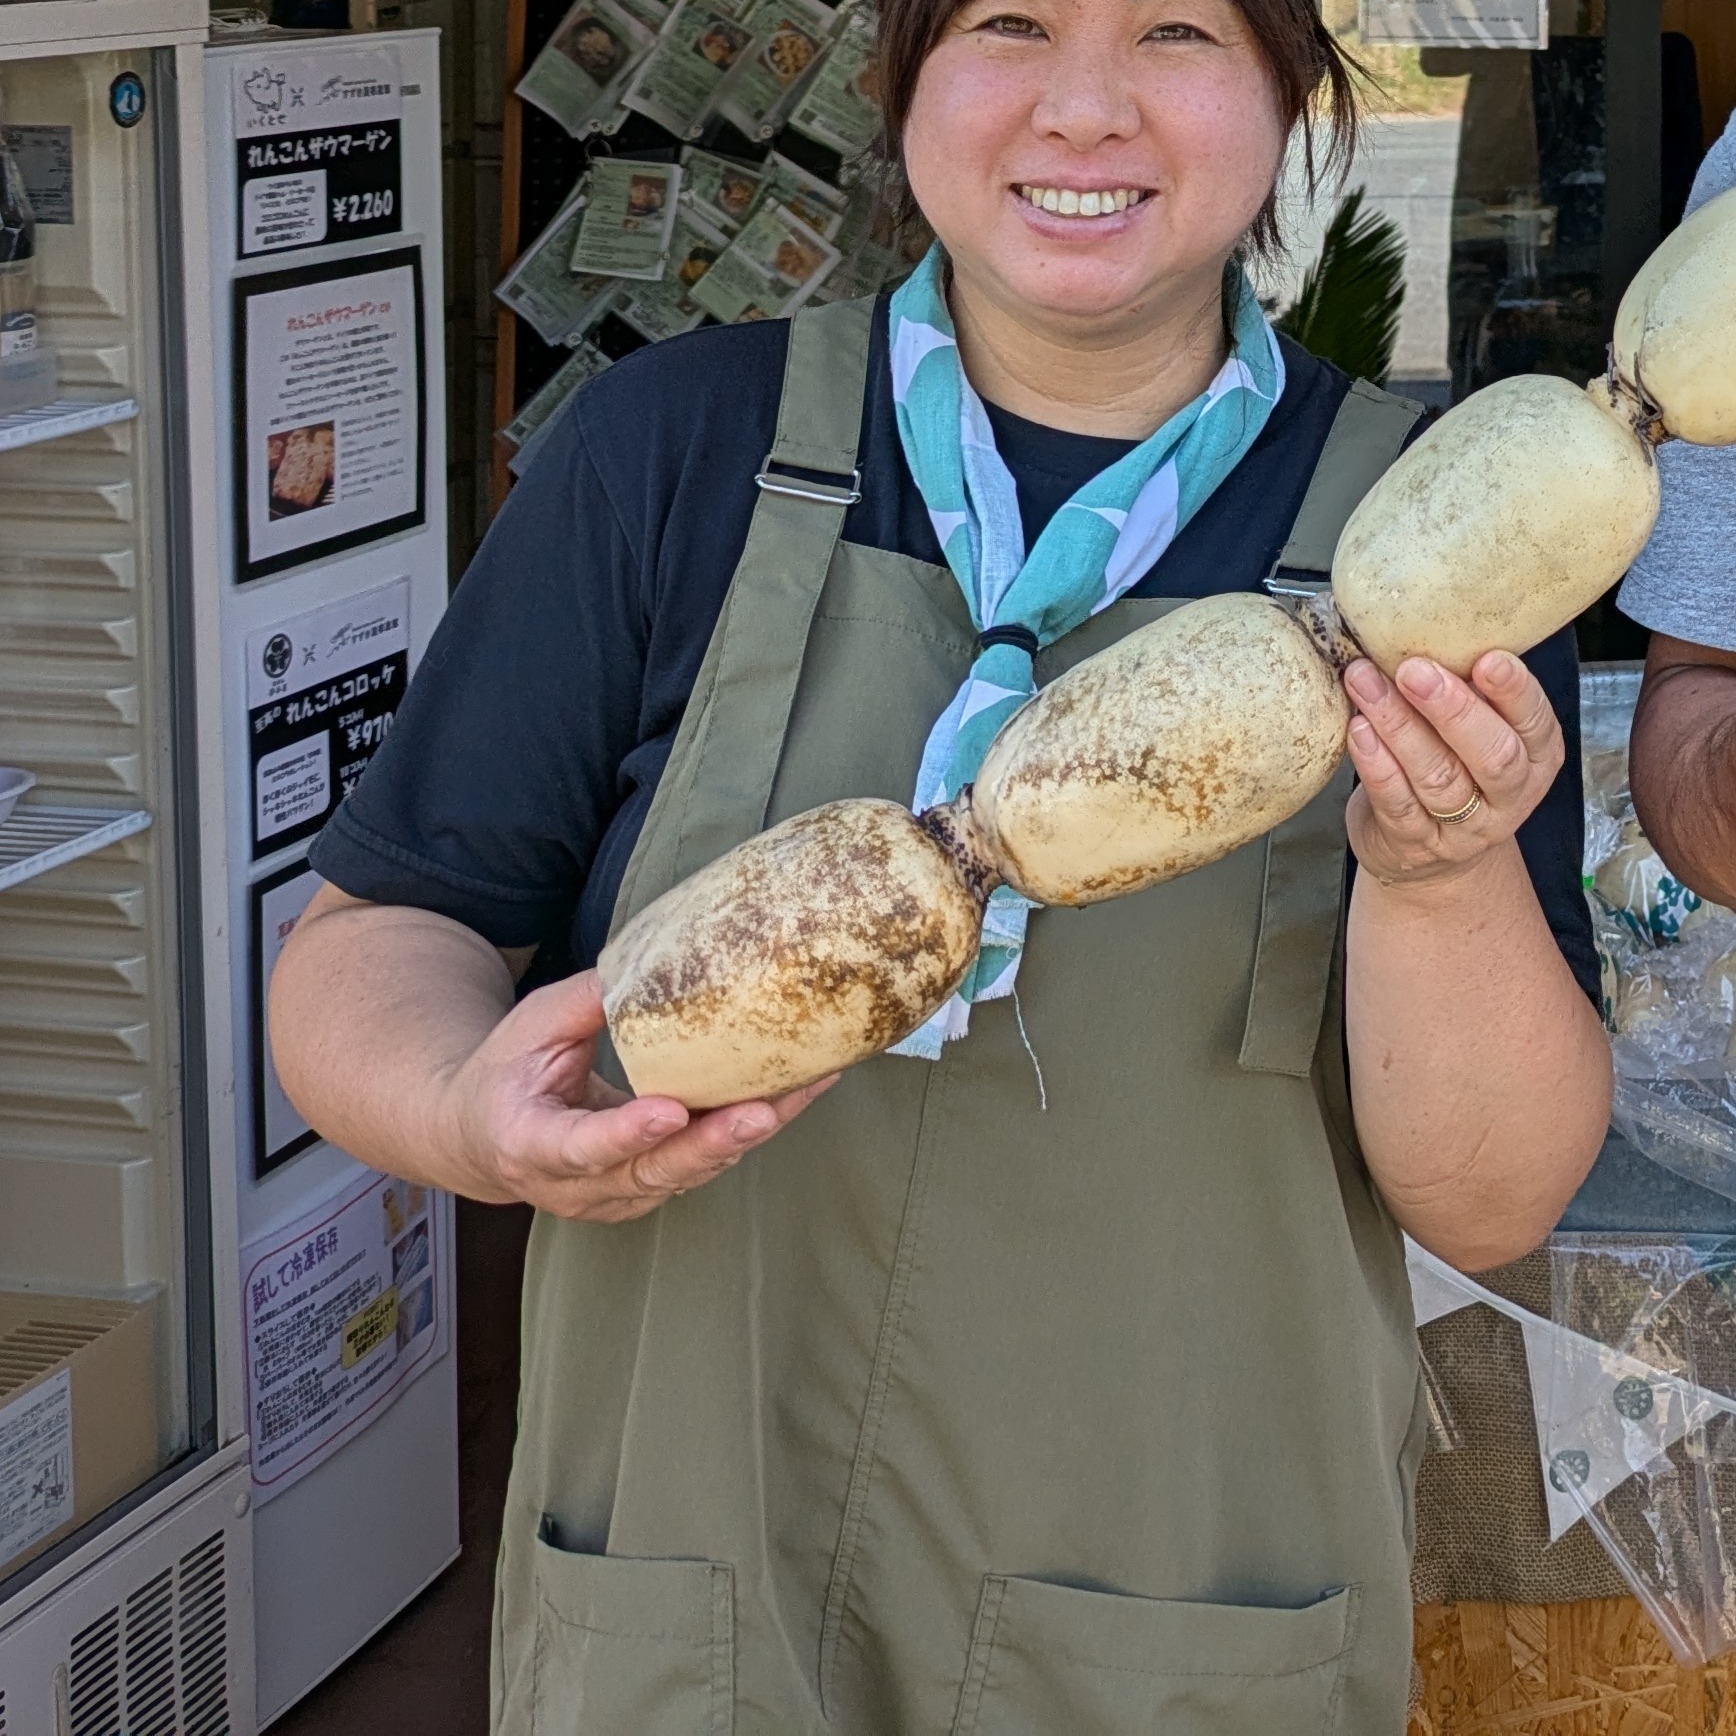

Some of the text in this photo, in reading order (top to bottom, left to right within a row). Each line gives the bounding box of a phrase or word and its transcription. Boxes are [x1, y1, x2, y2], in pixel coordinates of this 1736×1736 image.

[247, 129, 392, 168] れんこんザウマーゲン
[285, 664, 396, 725] れんこんコロッケ
